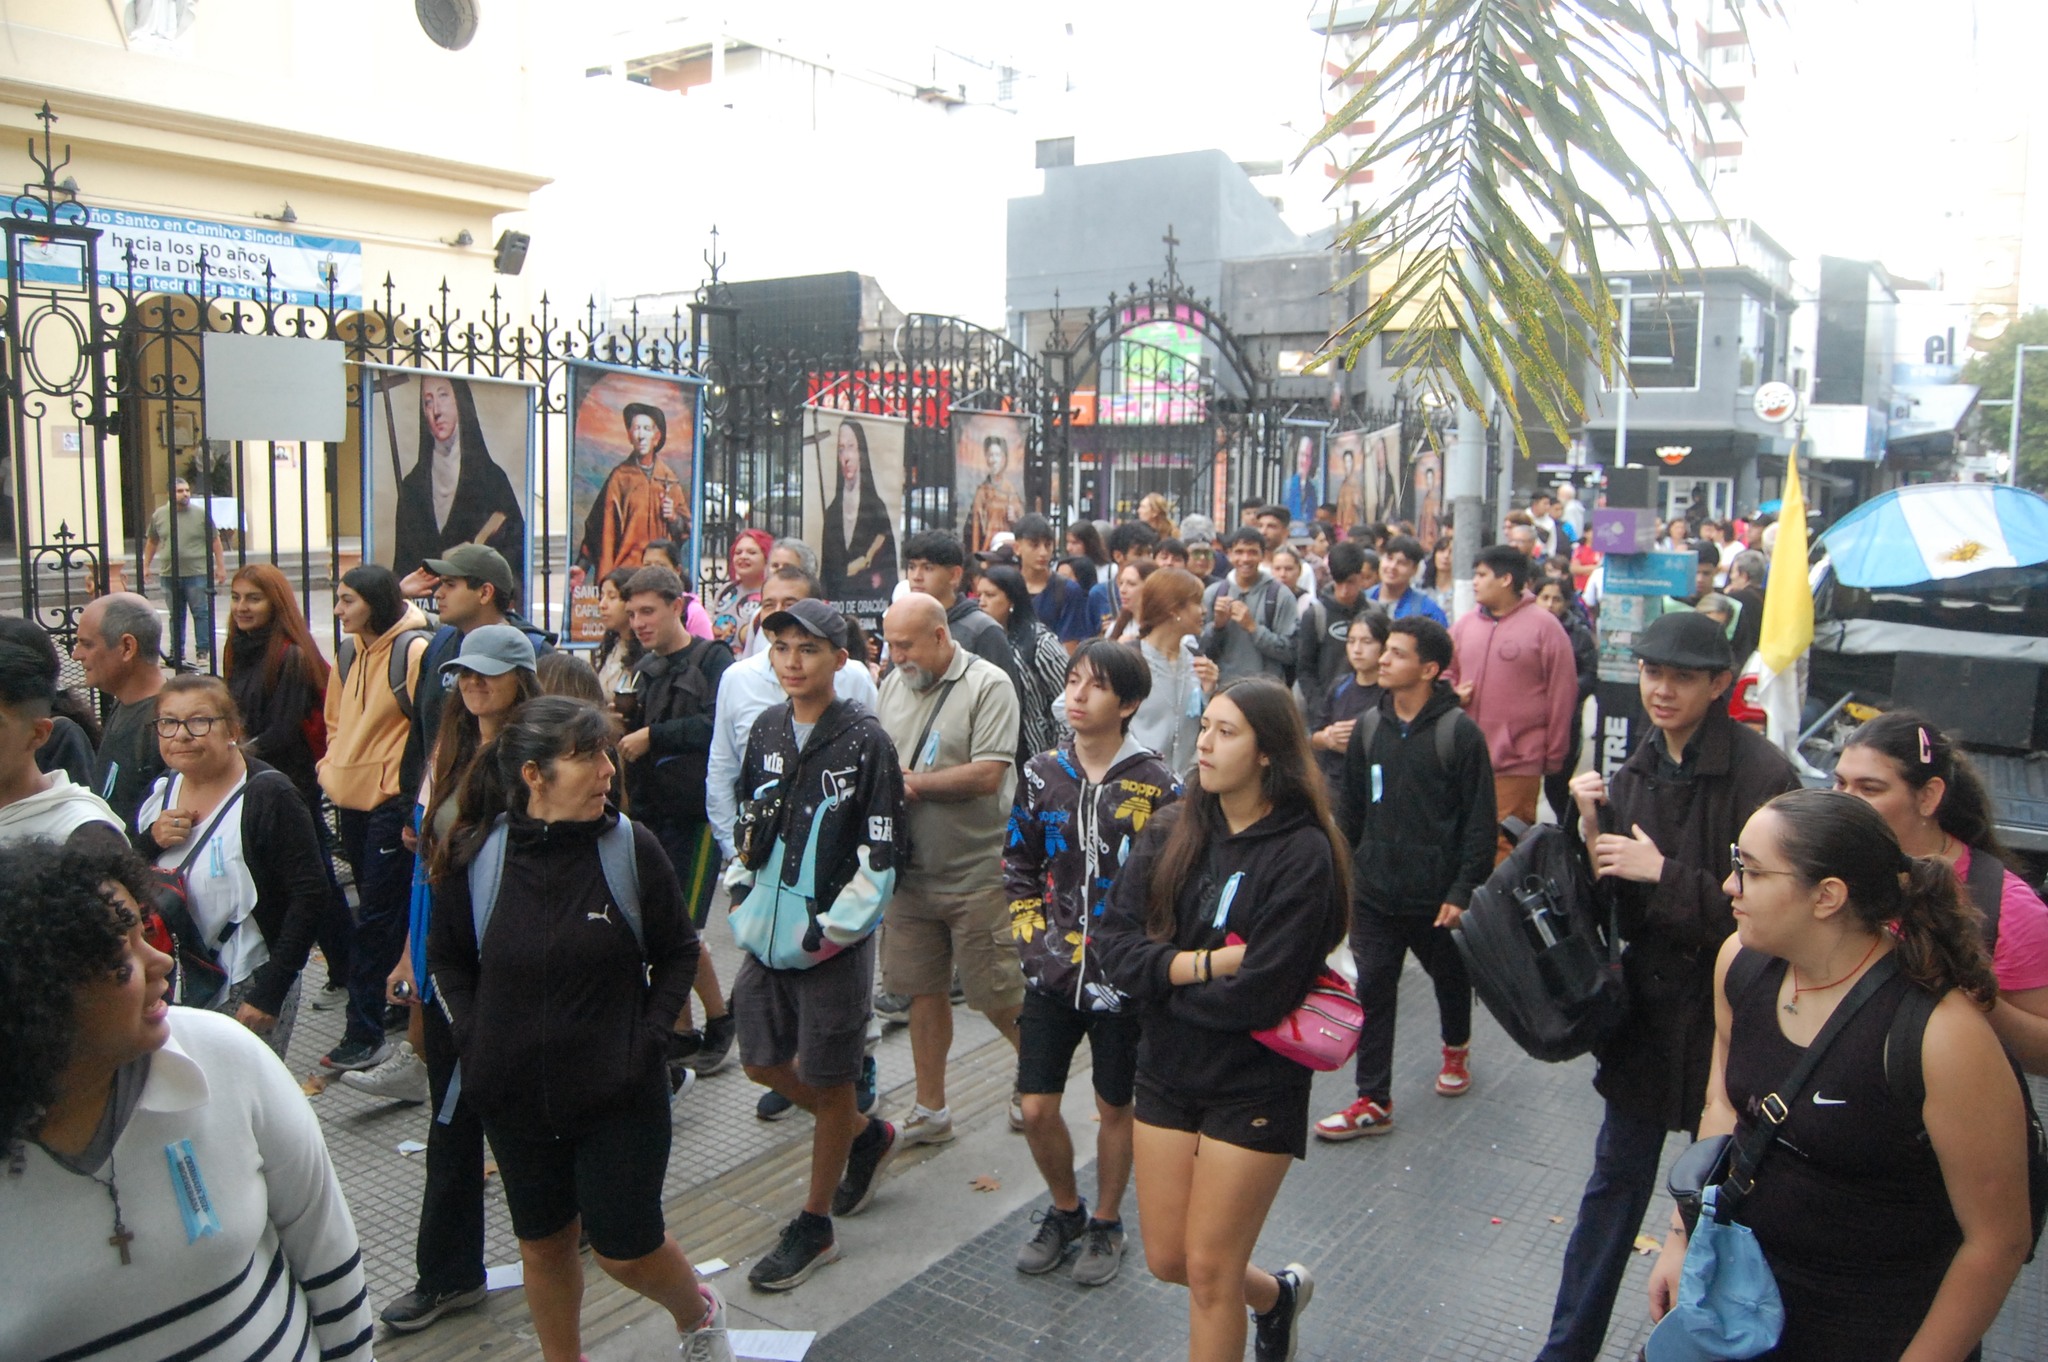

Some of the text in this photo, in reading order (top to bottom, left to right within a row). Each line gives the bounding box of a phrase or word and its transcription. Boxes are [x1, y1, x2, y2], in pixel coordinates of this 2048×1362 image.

[115, 212, 160, 229] Santo
[163, 220, 182, 232] en
[186, 221, 241, 240] Camino
[245, 228, 295, 247] Sinodal
[112, 232, 267, 265] hacia los 50 años
[156, 256, 171, 272] la
[574, 585, 600, 599] SANT
